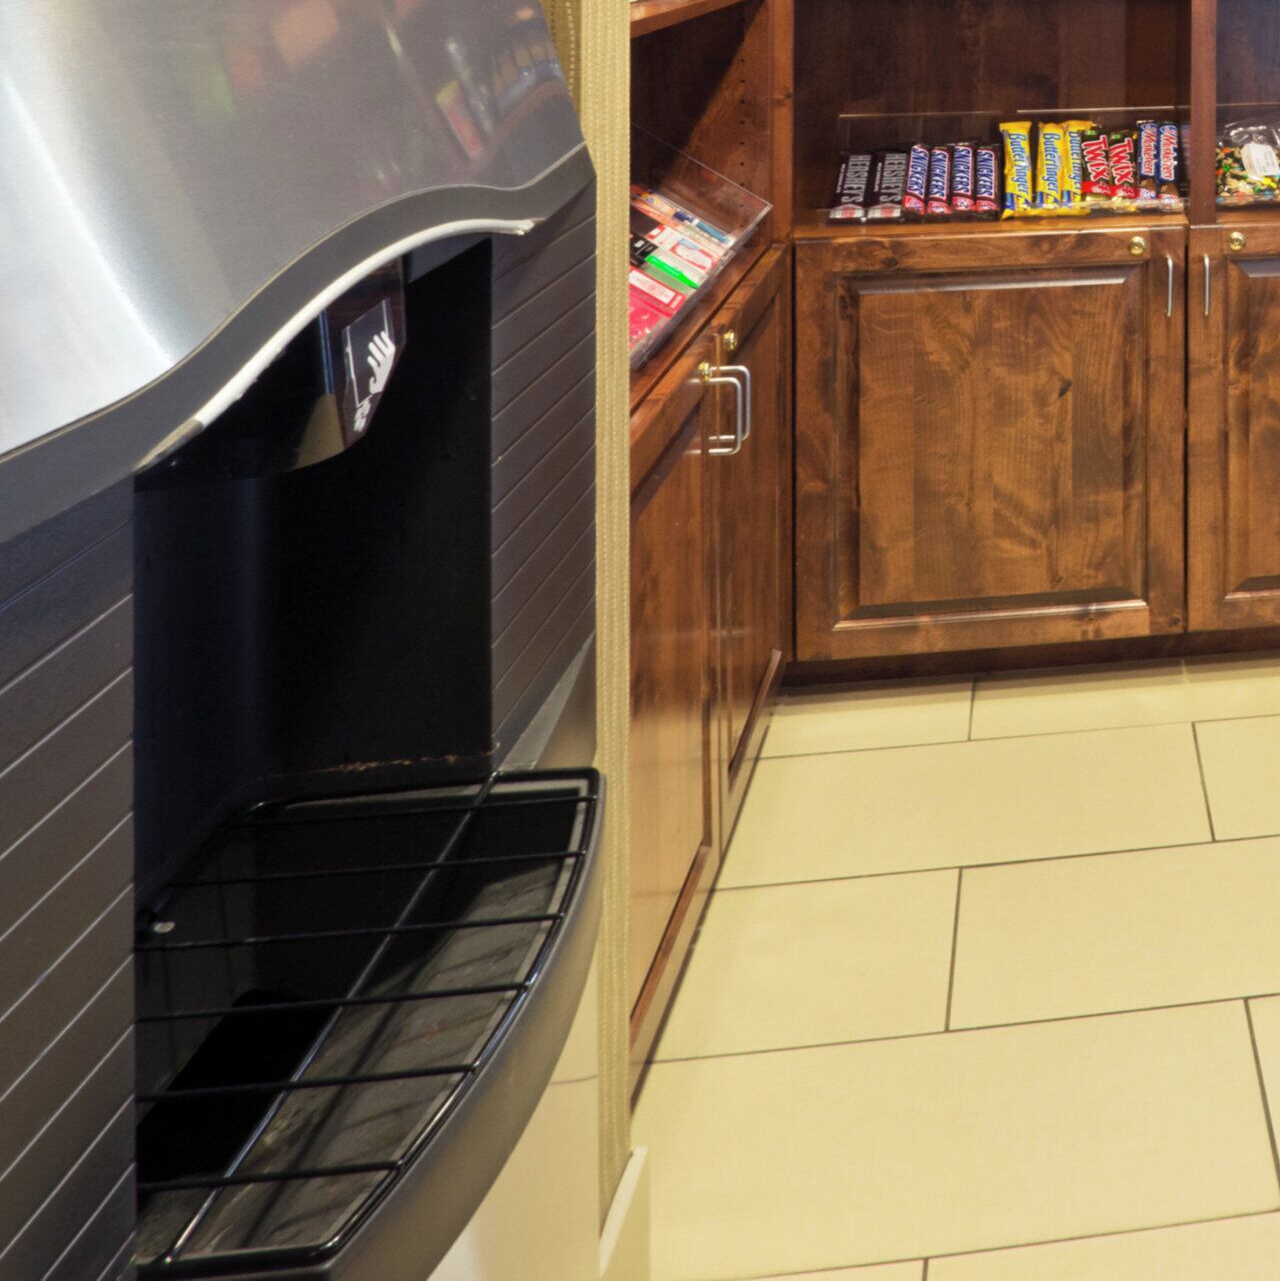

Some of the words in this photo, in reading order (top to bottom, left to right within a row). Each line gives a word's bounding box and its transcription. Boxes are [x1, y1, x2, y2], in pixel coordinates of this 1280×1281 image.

[841, 154, 872, 203] HERSHEY'S
[907, 146, 929, 198] SNICKERS
[928, 150, 949, 199] SNICKERS
[952, 145, 972, 193] SNICKERS
[976, 150, 995, 197] SNICKERS
[1008, 132, 1030, 195] Butterfinger
[1042, 132, 1061, 193] Butterfinger
[1082, 134, 1110, 181] TWIX
[1109, 137, 1134, 185] TWIX
